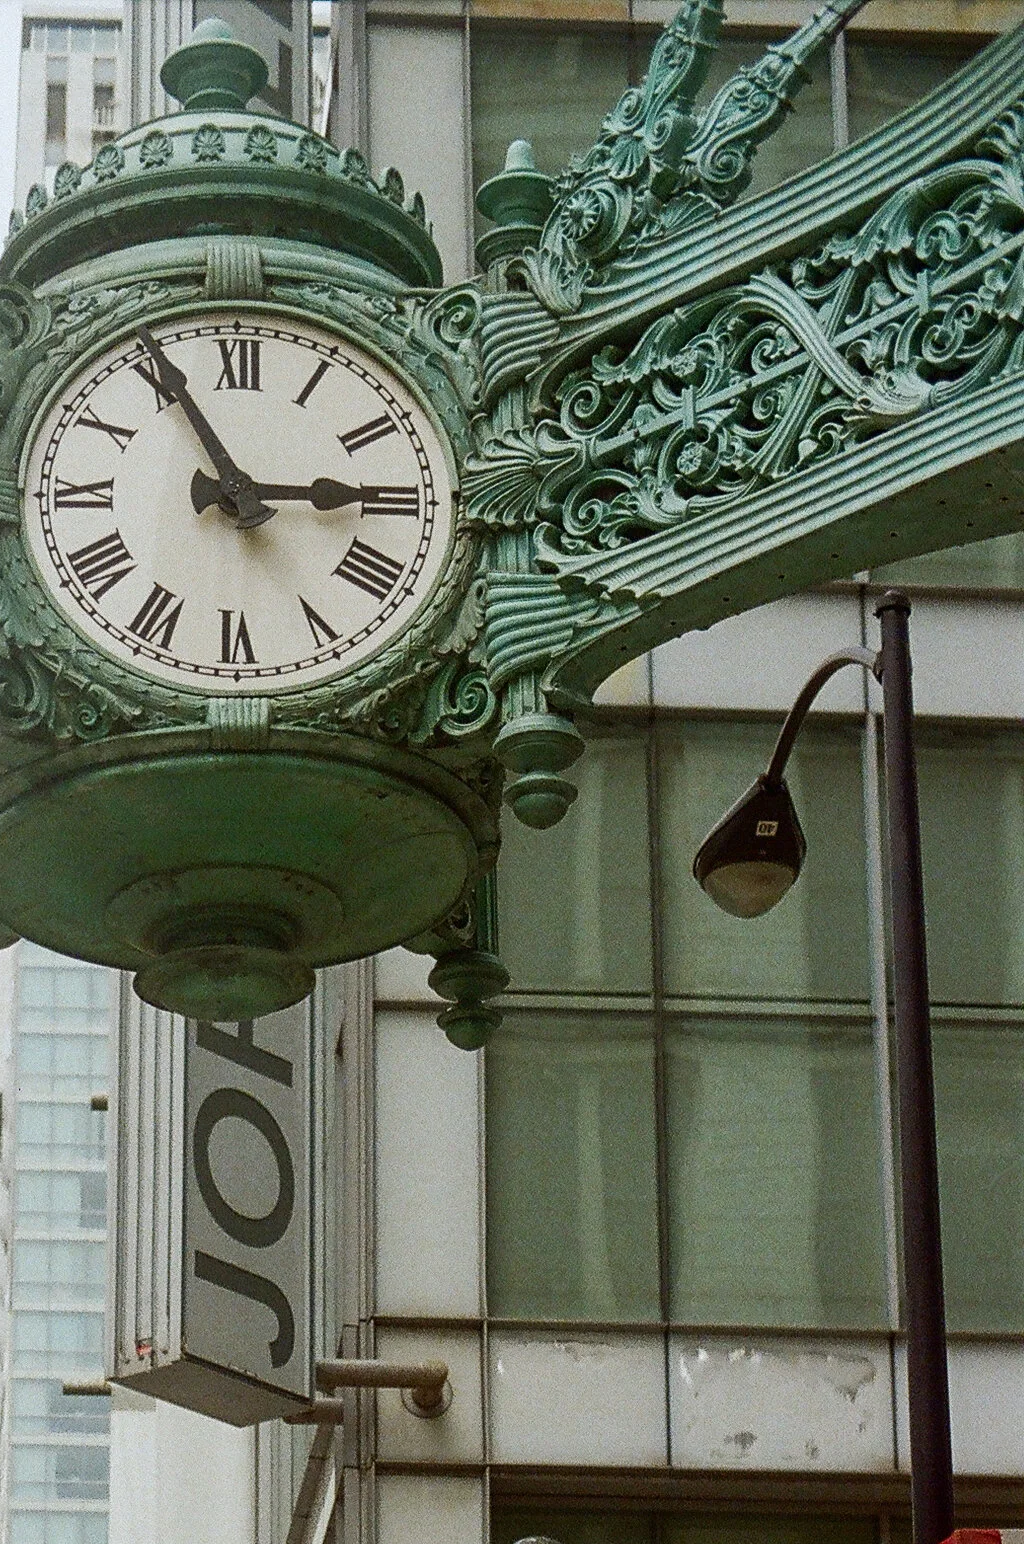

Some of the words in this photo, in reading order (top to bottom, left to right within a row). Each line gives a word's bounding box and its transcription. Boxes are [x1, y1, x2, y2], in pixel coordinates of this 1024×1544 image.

[129, 357, 179, 413] X
[212, 339, 263, 391] XII
[73, 404, 138, 453] X
[337, 411, 401, 457] II
[54, 476, 114, 511] IX
[66, 528, 138, 604] VIII
[125, 582, 185, 652] VII
[217, 609, 259, 664] VI
